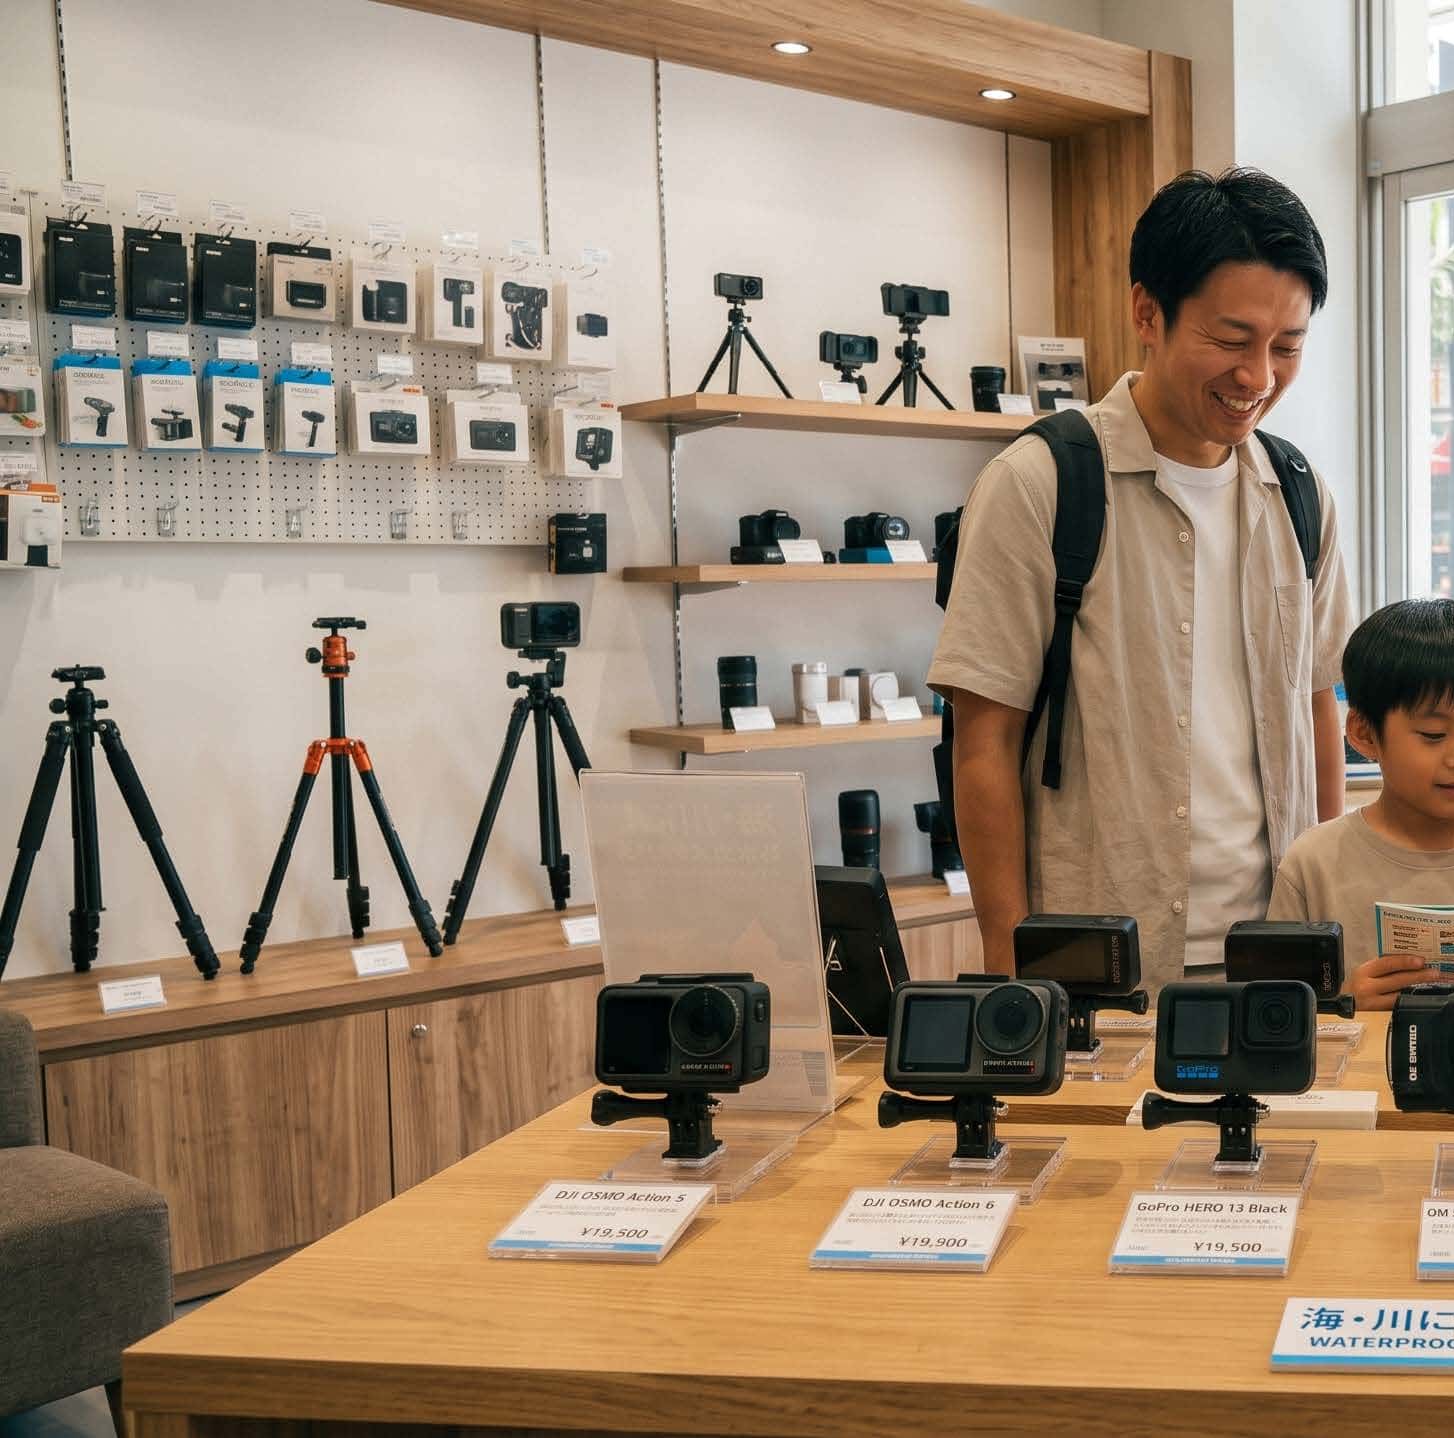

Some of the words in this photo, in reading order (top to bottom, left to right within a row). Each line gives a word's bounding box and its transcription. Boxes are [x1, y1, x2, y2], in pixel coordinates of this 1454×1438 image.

[555, 1190, 577, 1200] DJI
[581, 1191, 624, 1201] OSMO
[626, 1192, 671, 1202] Action
[675, 1193, 687, 1203] 5
[863, 1198, 885, 1207] DJI
[889, 1198, 932, 1208] OSMO
[935, 1199, 980, 1209] Action
[985, 1200, 995, 1210] 6
[1137, 1202, 1180, 1212] GoPro
[1184, 1202, 1223, 1213] HERO
[1228, 1203, 1244, 1213] 13
[1248, 1204, 1288, 1214] Black
[1427, 1208, 1449, 1218] OM
[580, 1227, 649, 1239] ¥19,500
[899, 1236, 968, 1248] ¥19,900
[1193, 1242, 1262, 1253] ¥19,500
